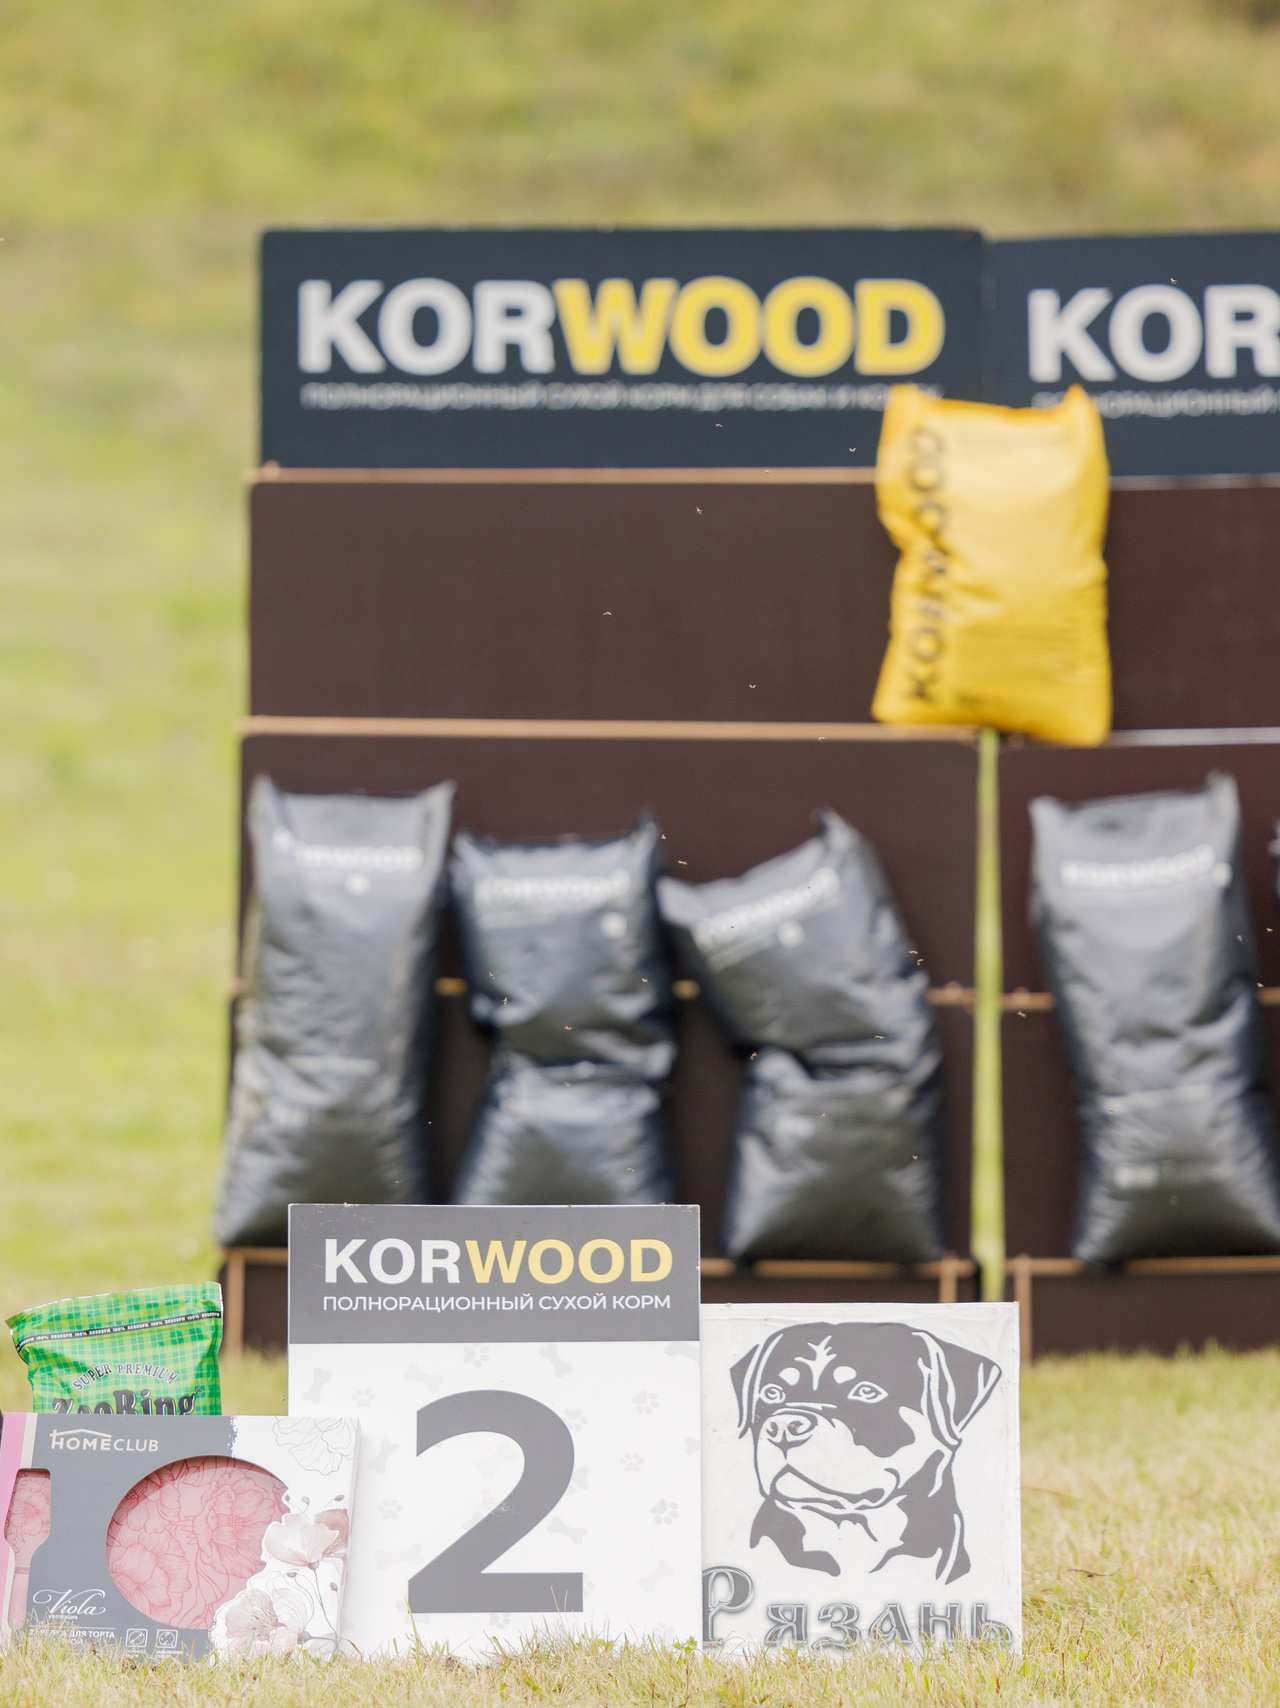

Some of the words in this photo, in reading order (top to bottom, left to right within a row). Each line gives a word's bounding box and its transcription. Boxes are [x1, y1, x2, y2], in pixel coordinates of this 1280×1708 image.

[297, 275, 945, 378] KORWOOD
[325, 1238, 673, 1284] KORWOOD
[323, 1293, 535, 1313] ПОЛНОРАЦИОННЫЙ
[538, 1292, 607, 1310] СУХОЙ
[612, 1295, 671, 1310] КОРМ
[72, 1363, 112, 1391] SUPER
[117, 1362, 179, 1385] PREMIUM
[49, 1429, 160, 1452] HOMECLUB
[408, 1389, 584, 1614] 2
[32, 1589, 106, 1616] Viola
[88, 1631, 116, 1639] ТОРТА
